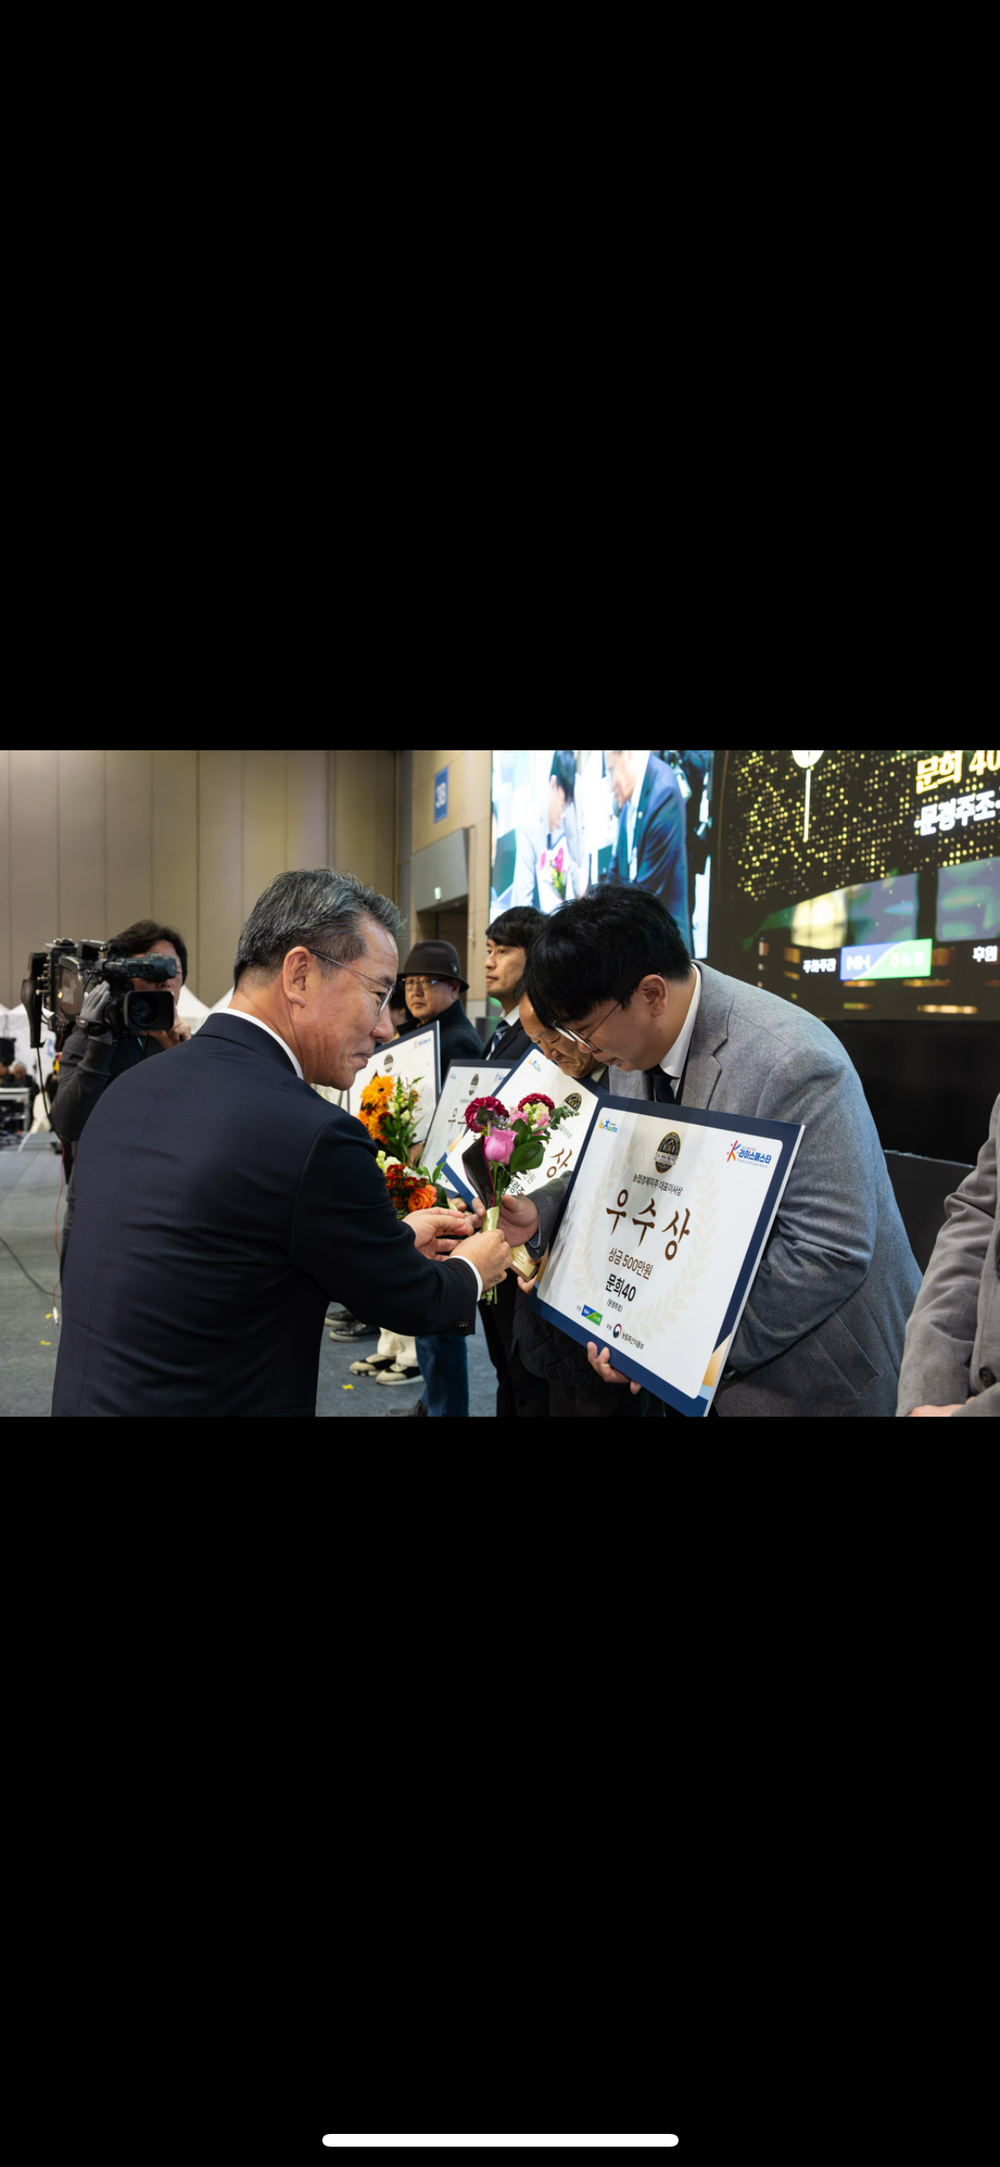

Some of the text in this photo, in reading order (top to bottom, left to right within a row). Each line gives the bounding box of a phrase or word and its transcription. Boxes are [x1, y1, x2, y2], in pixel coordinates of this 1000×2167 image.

[916, 750, 963, 795] 문희
[658, 1181, 684, 1197] 대표이사상
[608, 1247, 654, 1281] 상금 500만원
[605, 1273, 637, 1303] 문희40
